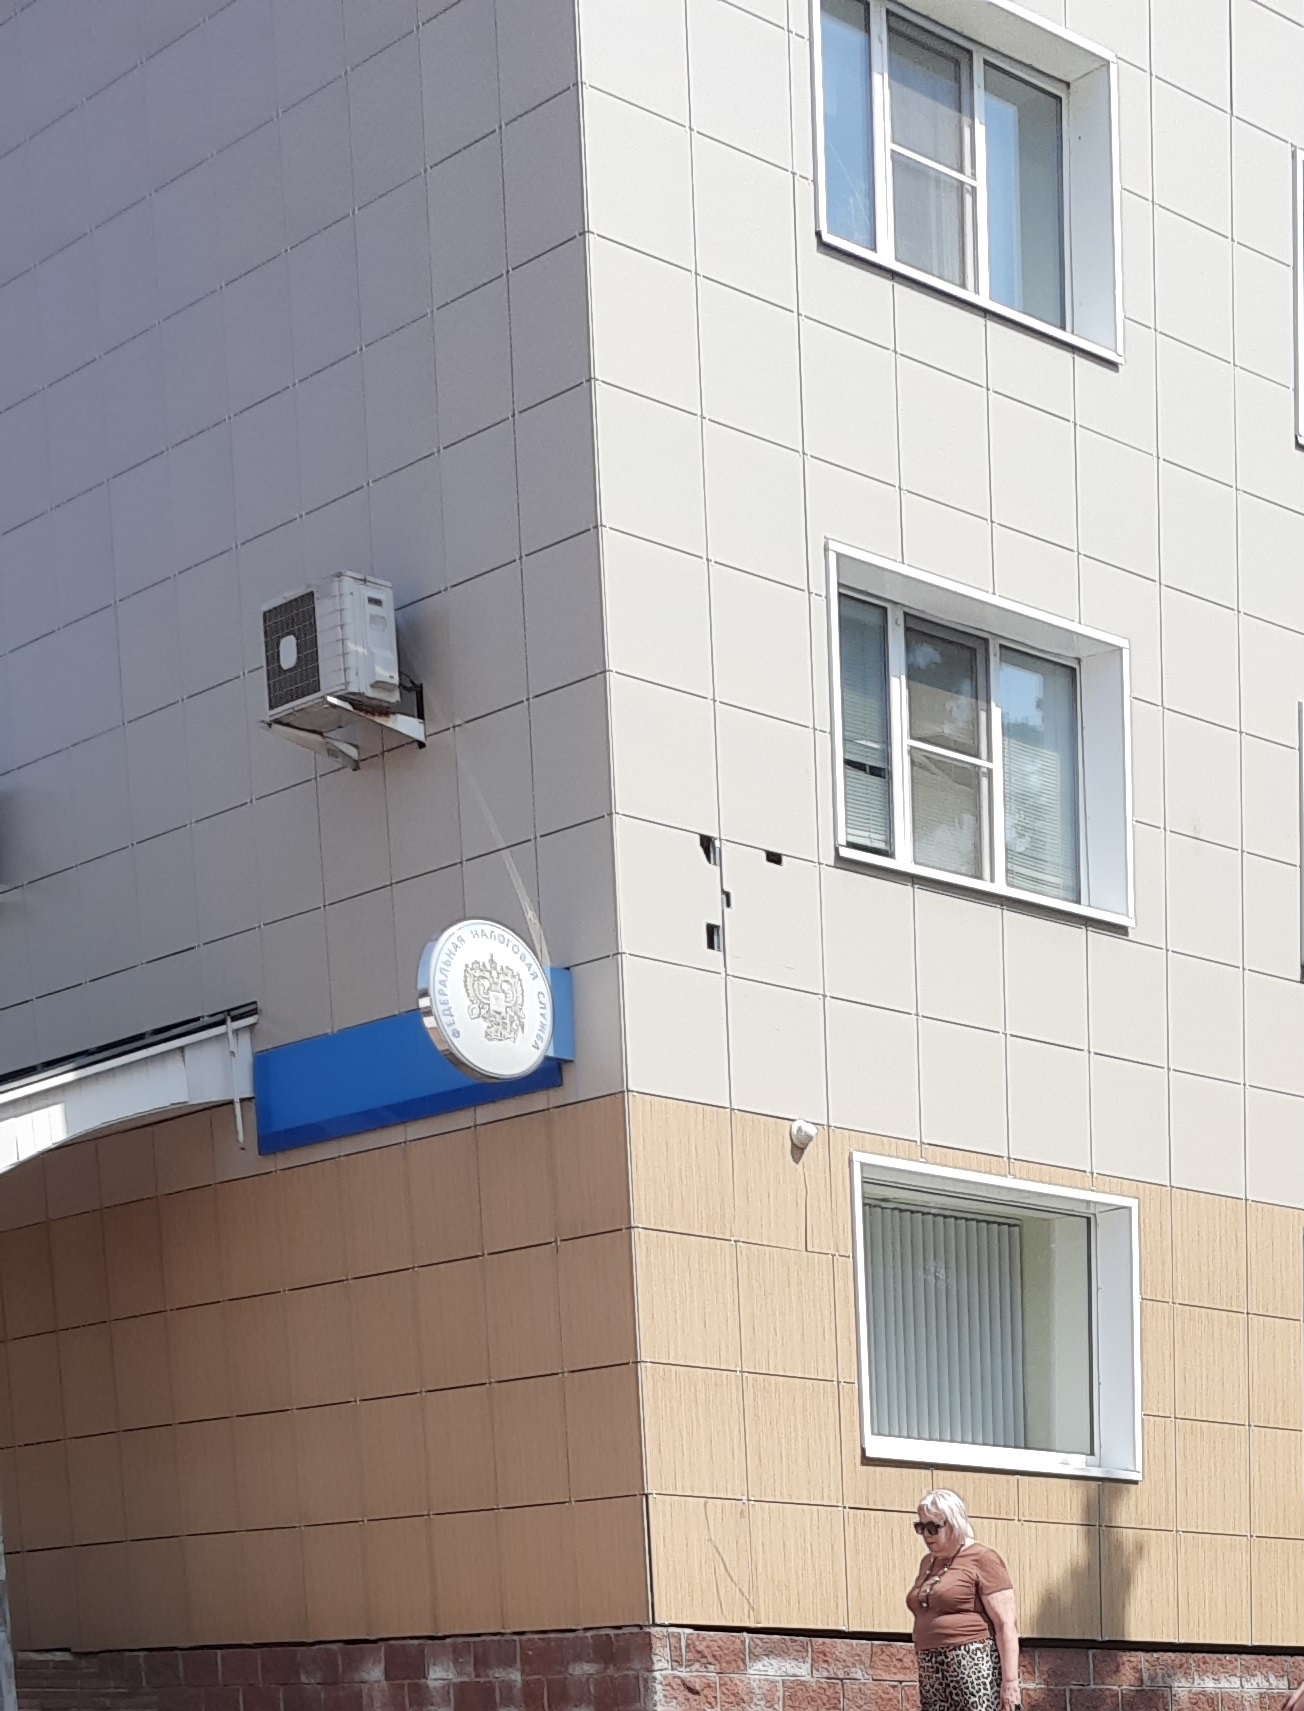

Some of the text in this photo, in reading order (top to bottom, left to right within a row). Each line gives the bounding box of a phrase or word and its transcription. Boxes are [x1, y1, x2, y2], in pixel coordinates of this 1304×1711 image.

[438, 929, 548, 1051] ФЕДЕРАЛЬНАЯ НАЛОГОВАЯ СЛУЖБА
